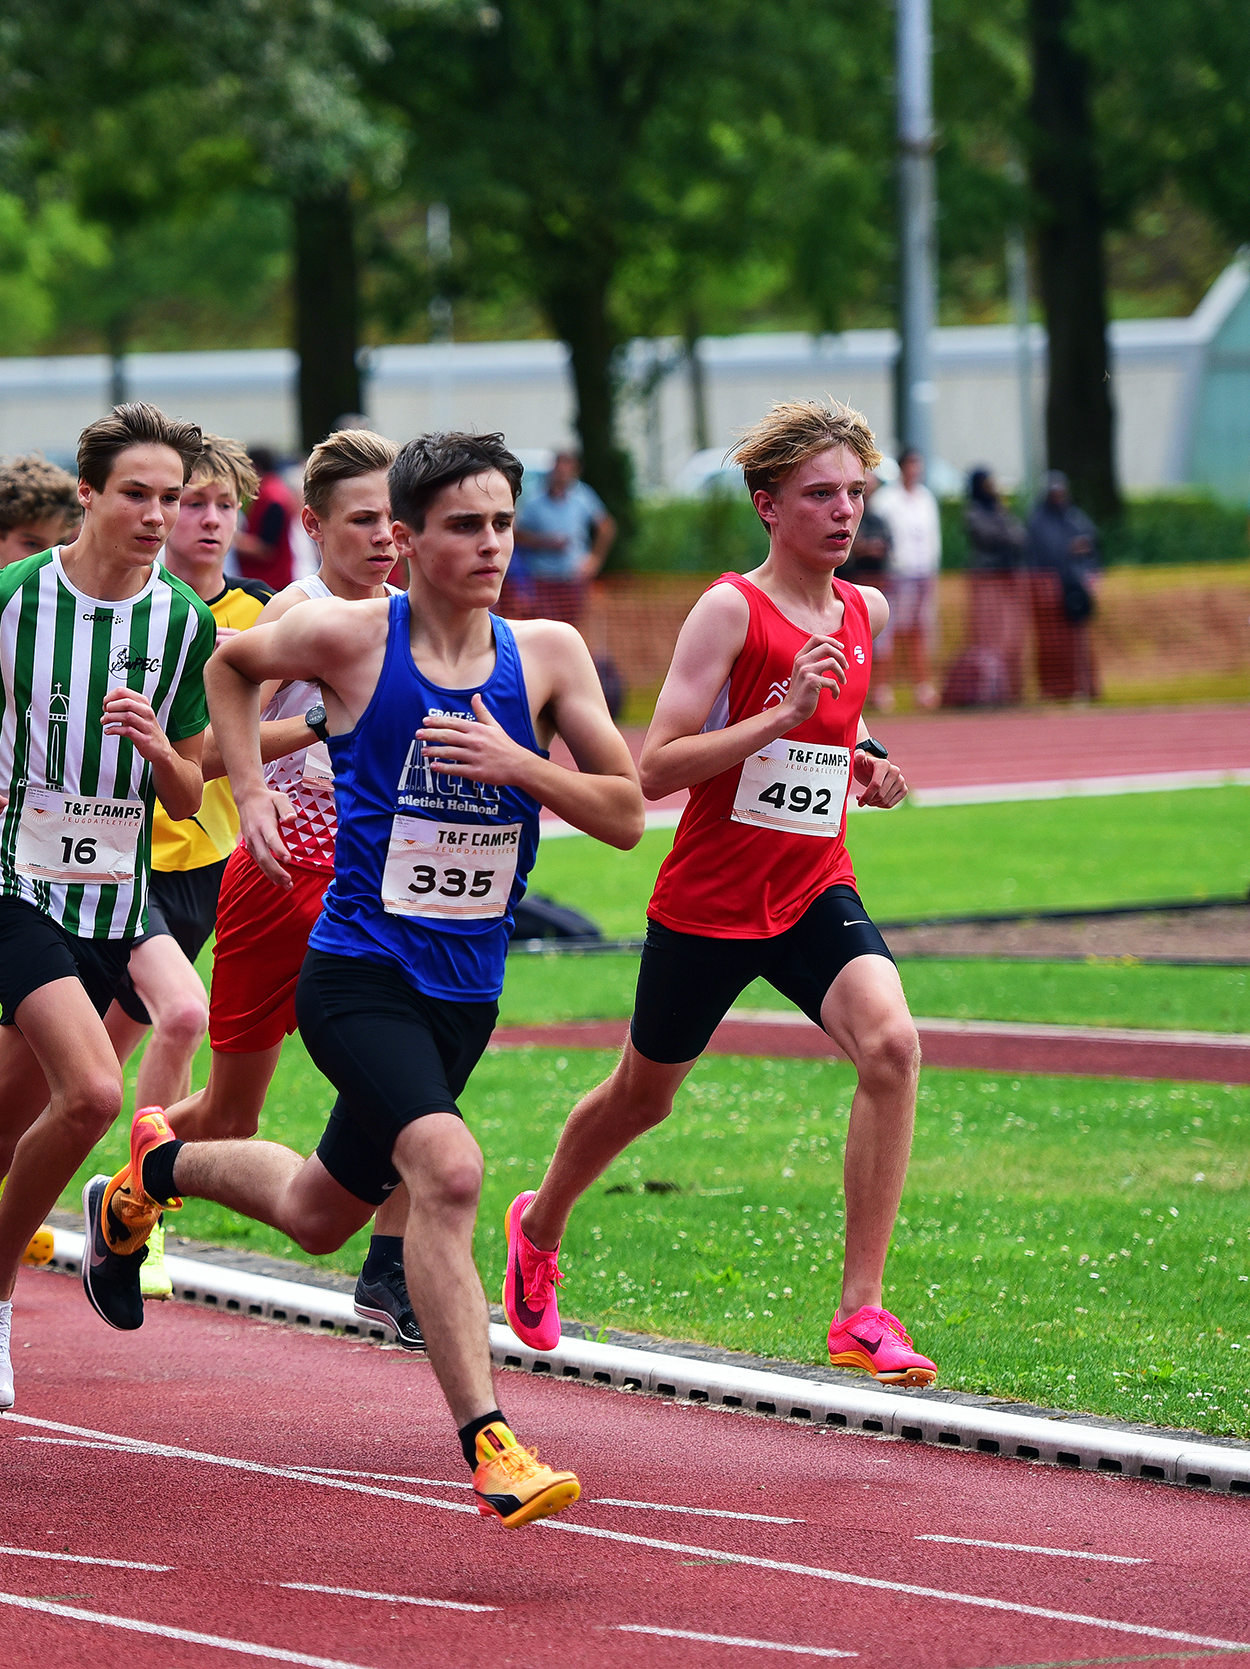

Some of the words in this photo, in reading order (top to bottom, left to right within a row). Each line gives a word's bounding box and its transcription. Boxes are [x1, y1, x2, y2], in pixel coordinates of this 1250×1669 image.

[83, 613, 115, 623] CRAFT
[428, 708, 465, 719] CRAFT
[788, 748, 814, 764] T&F
[815, 752, 848, 768] CAMPS
[785, 763, 848, 775] JEUGDATLETIEK
[397, 794, 445, 810] atletiek
[446, 799, 499, 815] Helmond
[757, 781, 832, 816] 492
[64, 801, 91, 816] T&F
[93, 804, 142, 820] CAMPS
[62, 816, 139, 827] JEUGDATLETIEK
[438, 830, 469, 846] T&F
[471, 831, 518, 847] CAMPS
[60, 836, 98, 865] 16
[435, 846, 516, 856] JEUGDATLETIEK
[407, 864, 495, 898] 335
